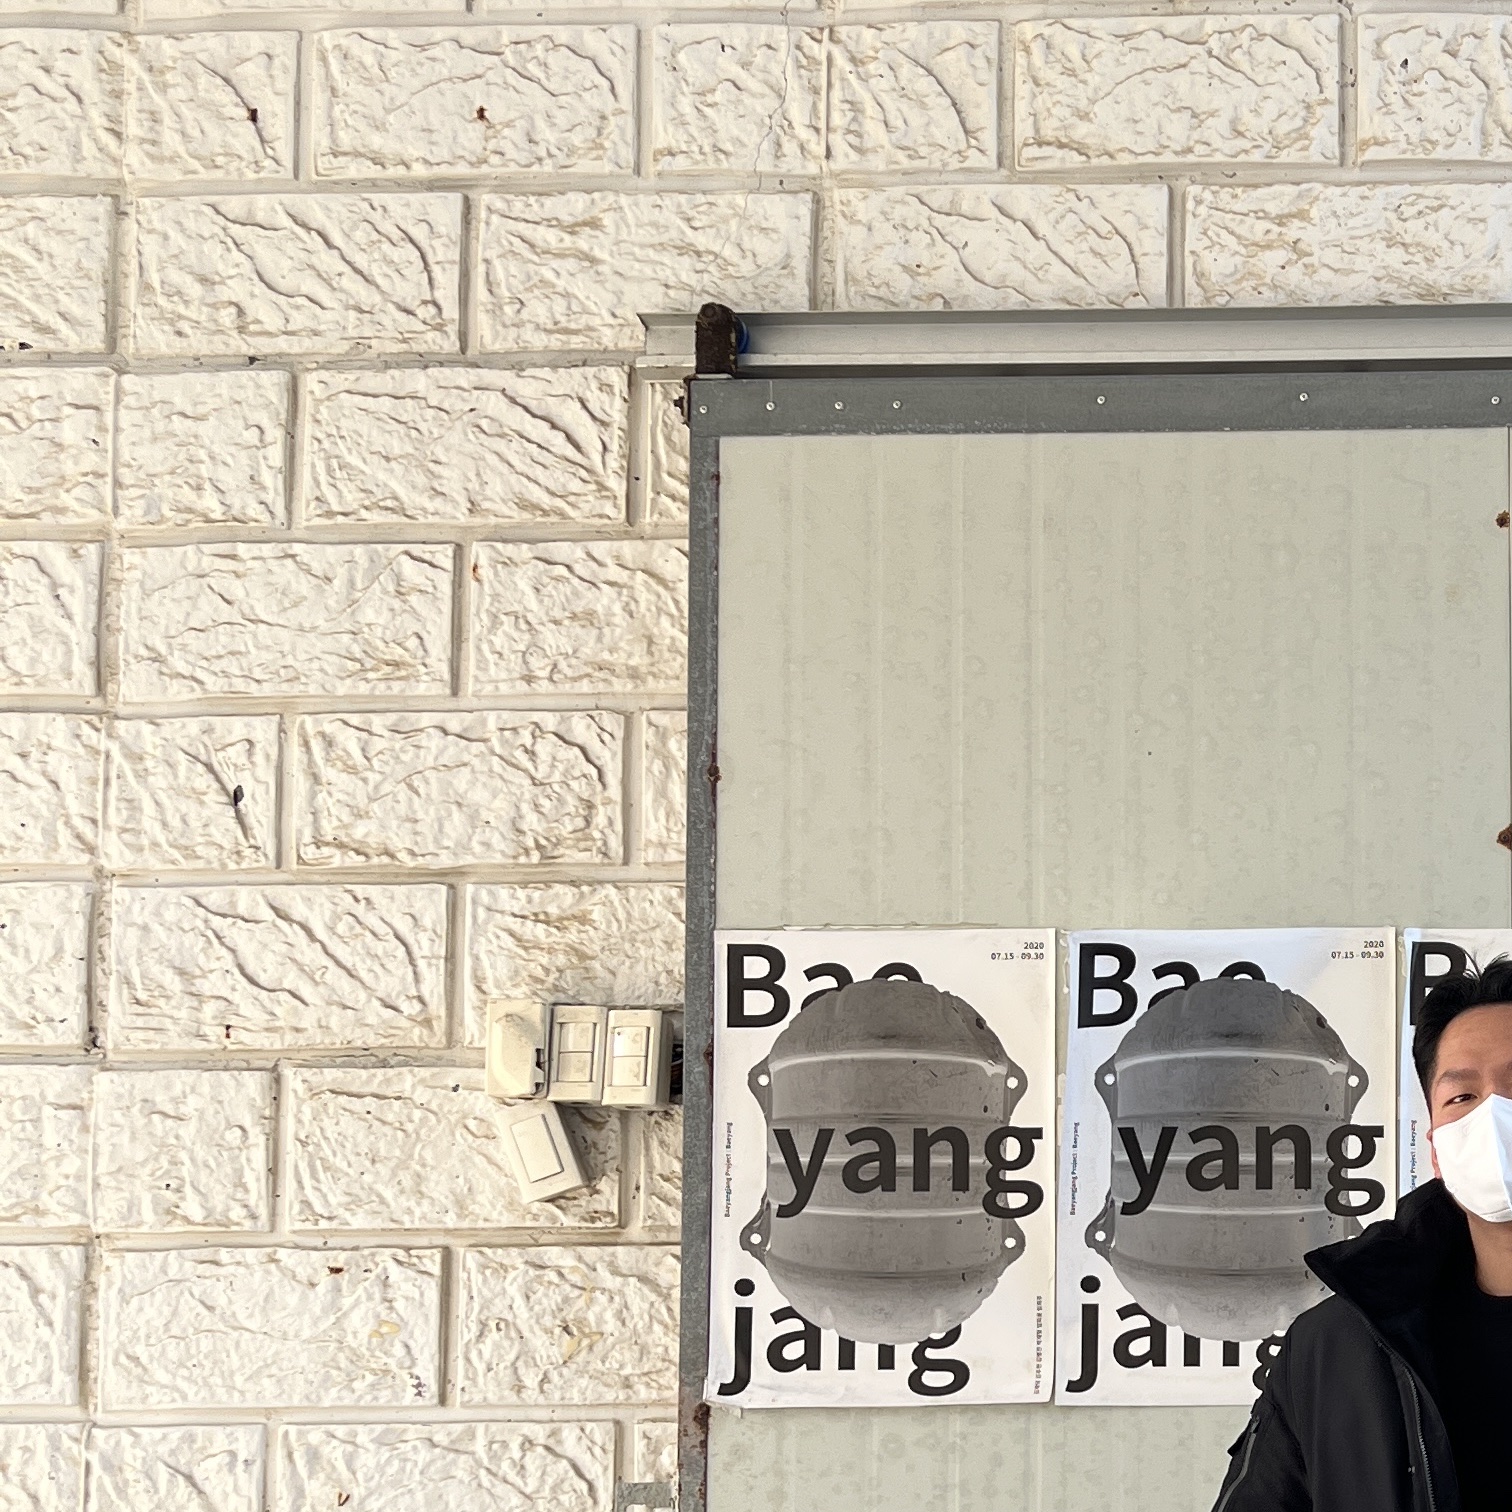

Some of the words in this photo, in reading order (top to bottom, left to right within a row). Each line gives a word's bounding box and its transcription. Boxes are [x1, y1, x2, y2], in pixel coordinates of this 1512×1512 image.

[726, 943, 925, 1028] Ba
[1024, 942, 1045, 950] 2020
[1077, 943, 1267, 1029] Ba
[1364, 940, 1385, 948] 2020
[772, 1125, 1045, 1219] yang
[1117, 1123, 1386, 1216] yang
